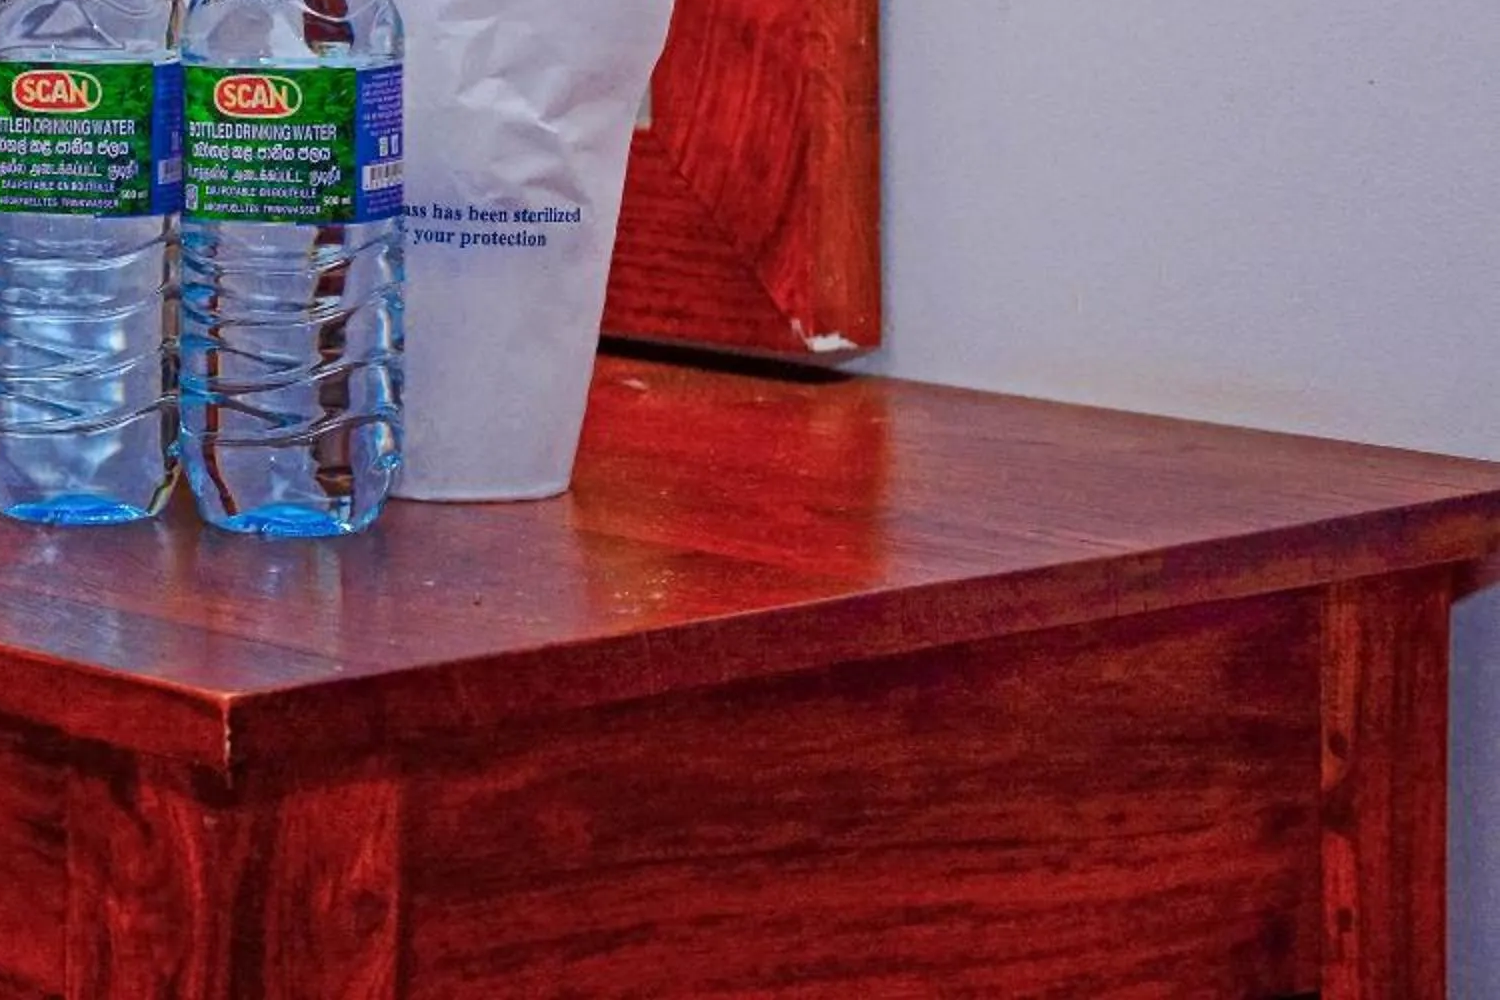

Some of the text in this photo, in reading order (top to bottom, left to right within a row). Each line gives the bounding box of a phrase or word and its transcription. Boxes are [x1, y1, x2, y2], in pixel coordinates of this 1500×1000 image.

[21, 74, 92, 106] SCAN
[222, 79, 292, 111] SCAN
[34, 117, 90, 134] DRINKING
[92, 119, 135, 135] WATER
[189, 121, 337, 141] BOTTLED DRINKING WATER
[401, 203, 581, 224] ass has been sterilized
[413, 228, 456, 245] your
[459, 230, 547, 249] protection
